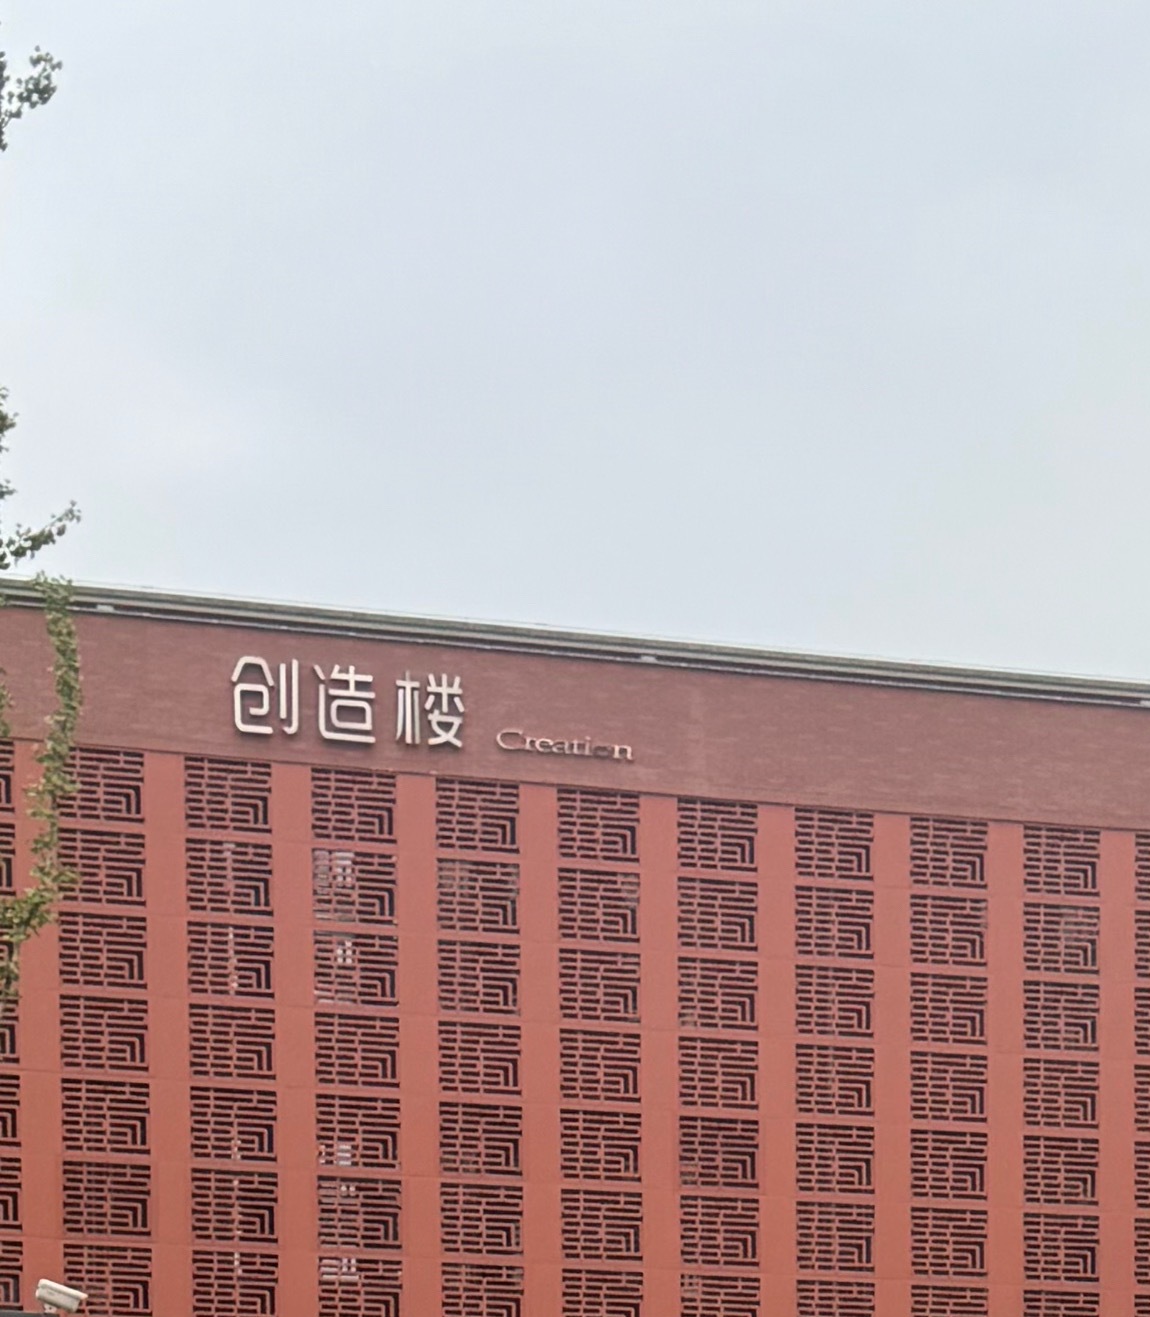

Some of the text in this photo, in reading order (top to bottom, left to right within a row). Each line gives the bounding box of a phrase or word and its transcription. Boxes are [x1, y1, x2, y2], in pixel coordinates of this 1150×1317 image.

[231, 655, 465, 748] 创造楼
[496, 728, 633, 760] Creation
